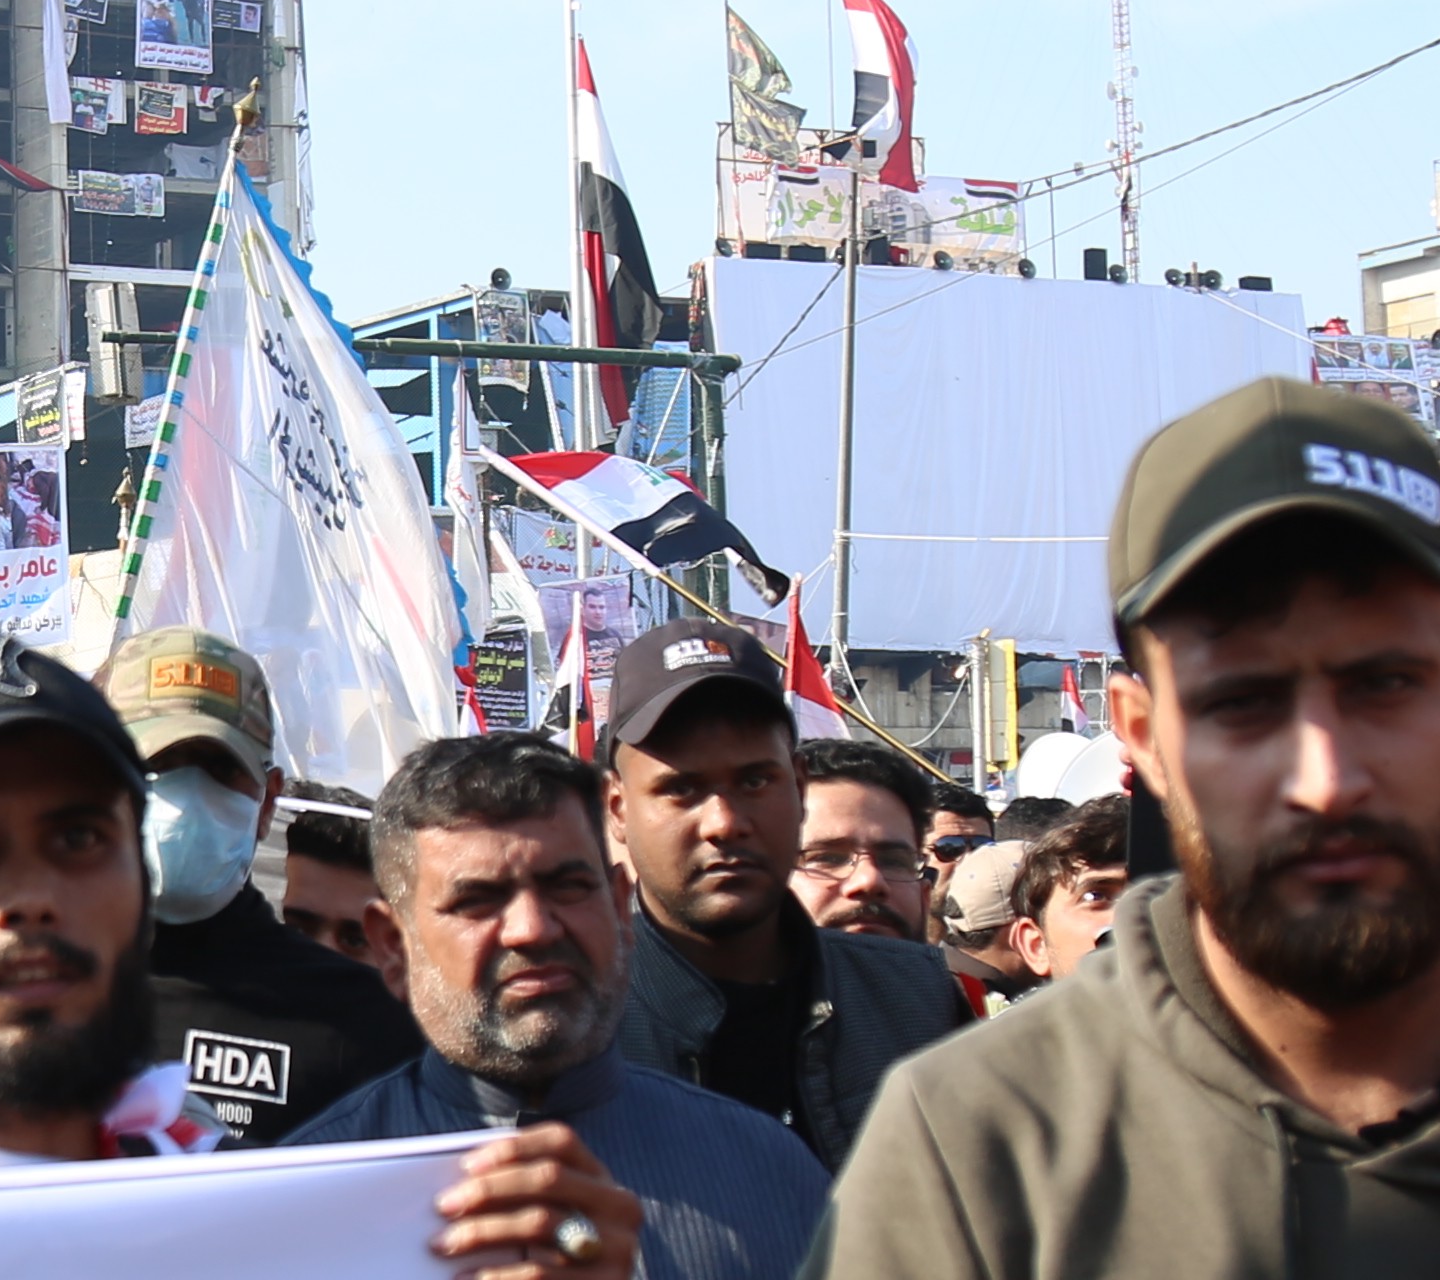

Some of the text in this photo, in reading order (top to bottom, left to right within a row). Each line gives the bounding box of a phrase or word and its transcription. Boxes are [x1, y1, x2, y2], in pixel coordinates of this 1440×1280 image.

[16, 554, 58, 585] عامر
[193, 1041, 277, 1092] HDA
[215, 1100, 254, 1126] HOOD
